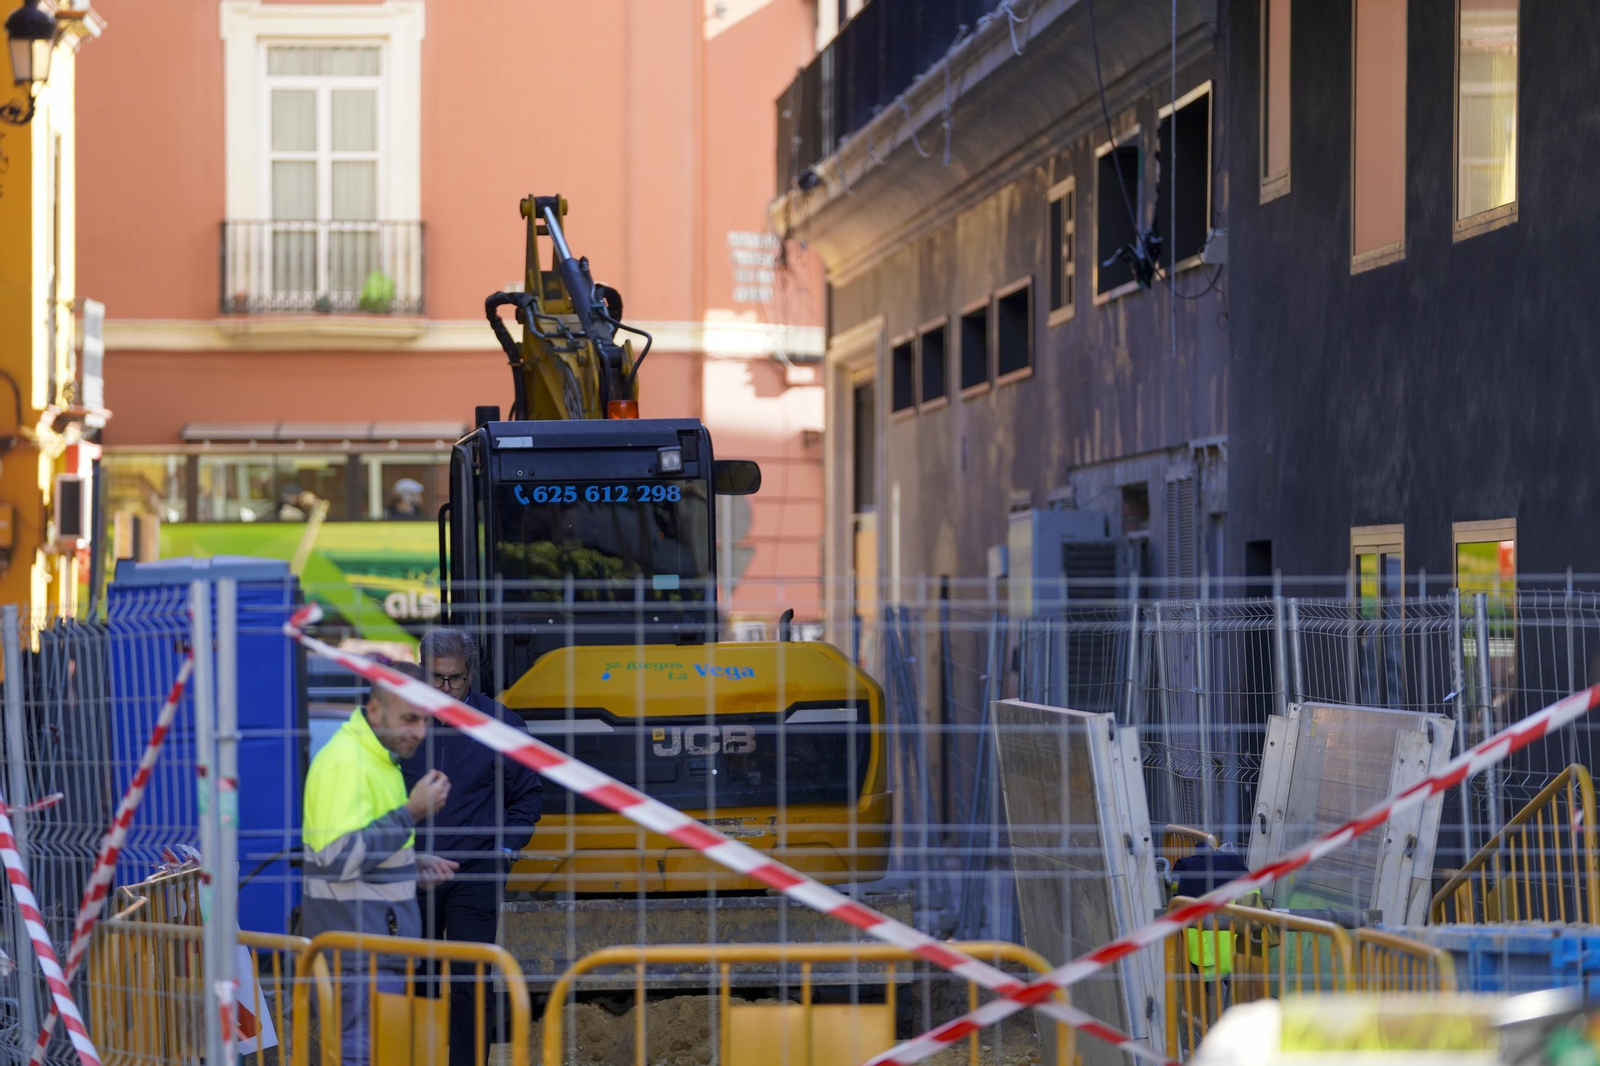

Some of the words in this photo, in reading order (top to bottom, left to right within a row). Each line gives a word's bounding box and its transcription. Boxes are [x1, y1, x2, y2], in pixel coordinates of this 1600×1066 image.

[533, 485, 577, 503] 625
[585, 485, 629, 502] 612
[636, 485, 682, 502] 298
[385, 588, 451, 619] als
[626, 660, 684, 672] Riegos
[692, 663, 756, 681] Vega
[668, 671, 688, 681] La
[652, 725, 757, 757] JCB
